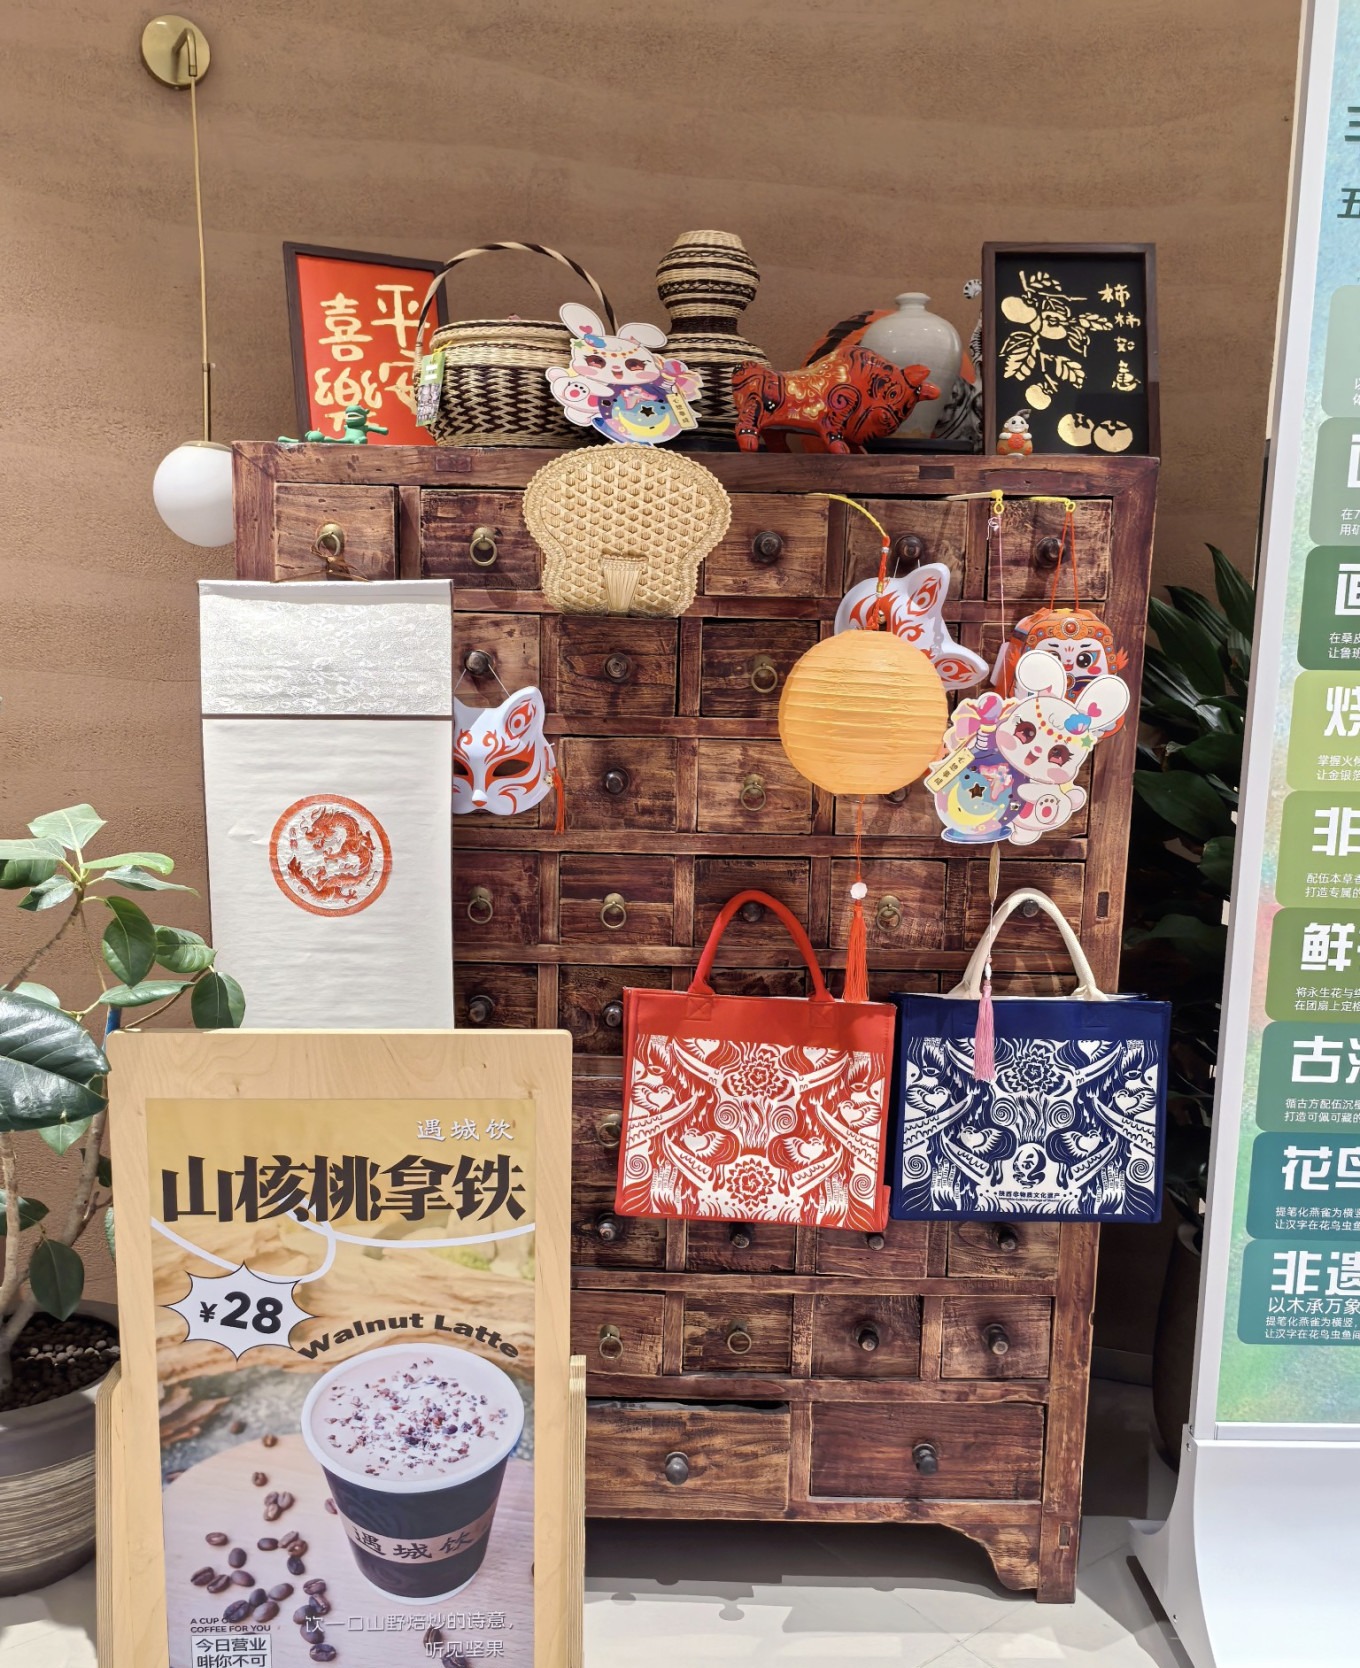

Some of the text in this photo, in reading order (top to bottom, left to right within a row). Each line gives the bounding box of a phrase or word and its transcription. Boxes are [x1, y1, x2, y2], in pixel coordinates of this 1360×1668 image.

[416, 1118, 515, 1142] 遇城饮
[161, 1153, 527, 1223] 山核桃拿铁
[297, 1312, 520, 1361] Walnut Latte
[190, 1624, 271, 1634] COFFEE FOR YOU
[199, 1617, 219, 1625] CUP
[195, 1637, 267, 1653] 今日营业
[424, 1640, 505, 1659] 听见坚果
